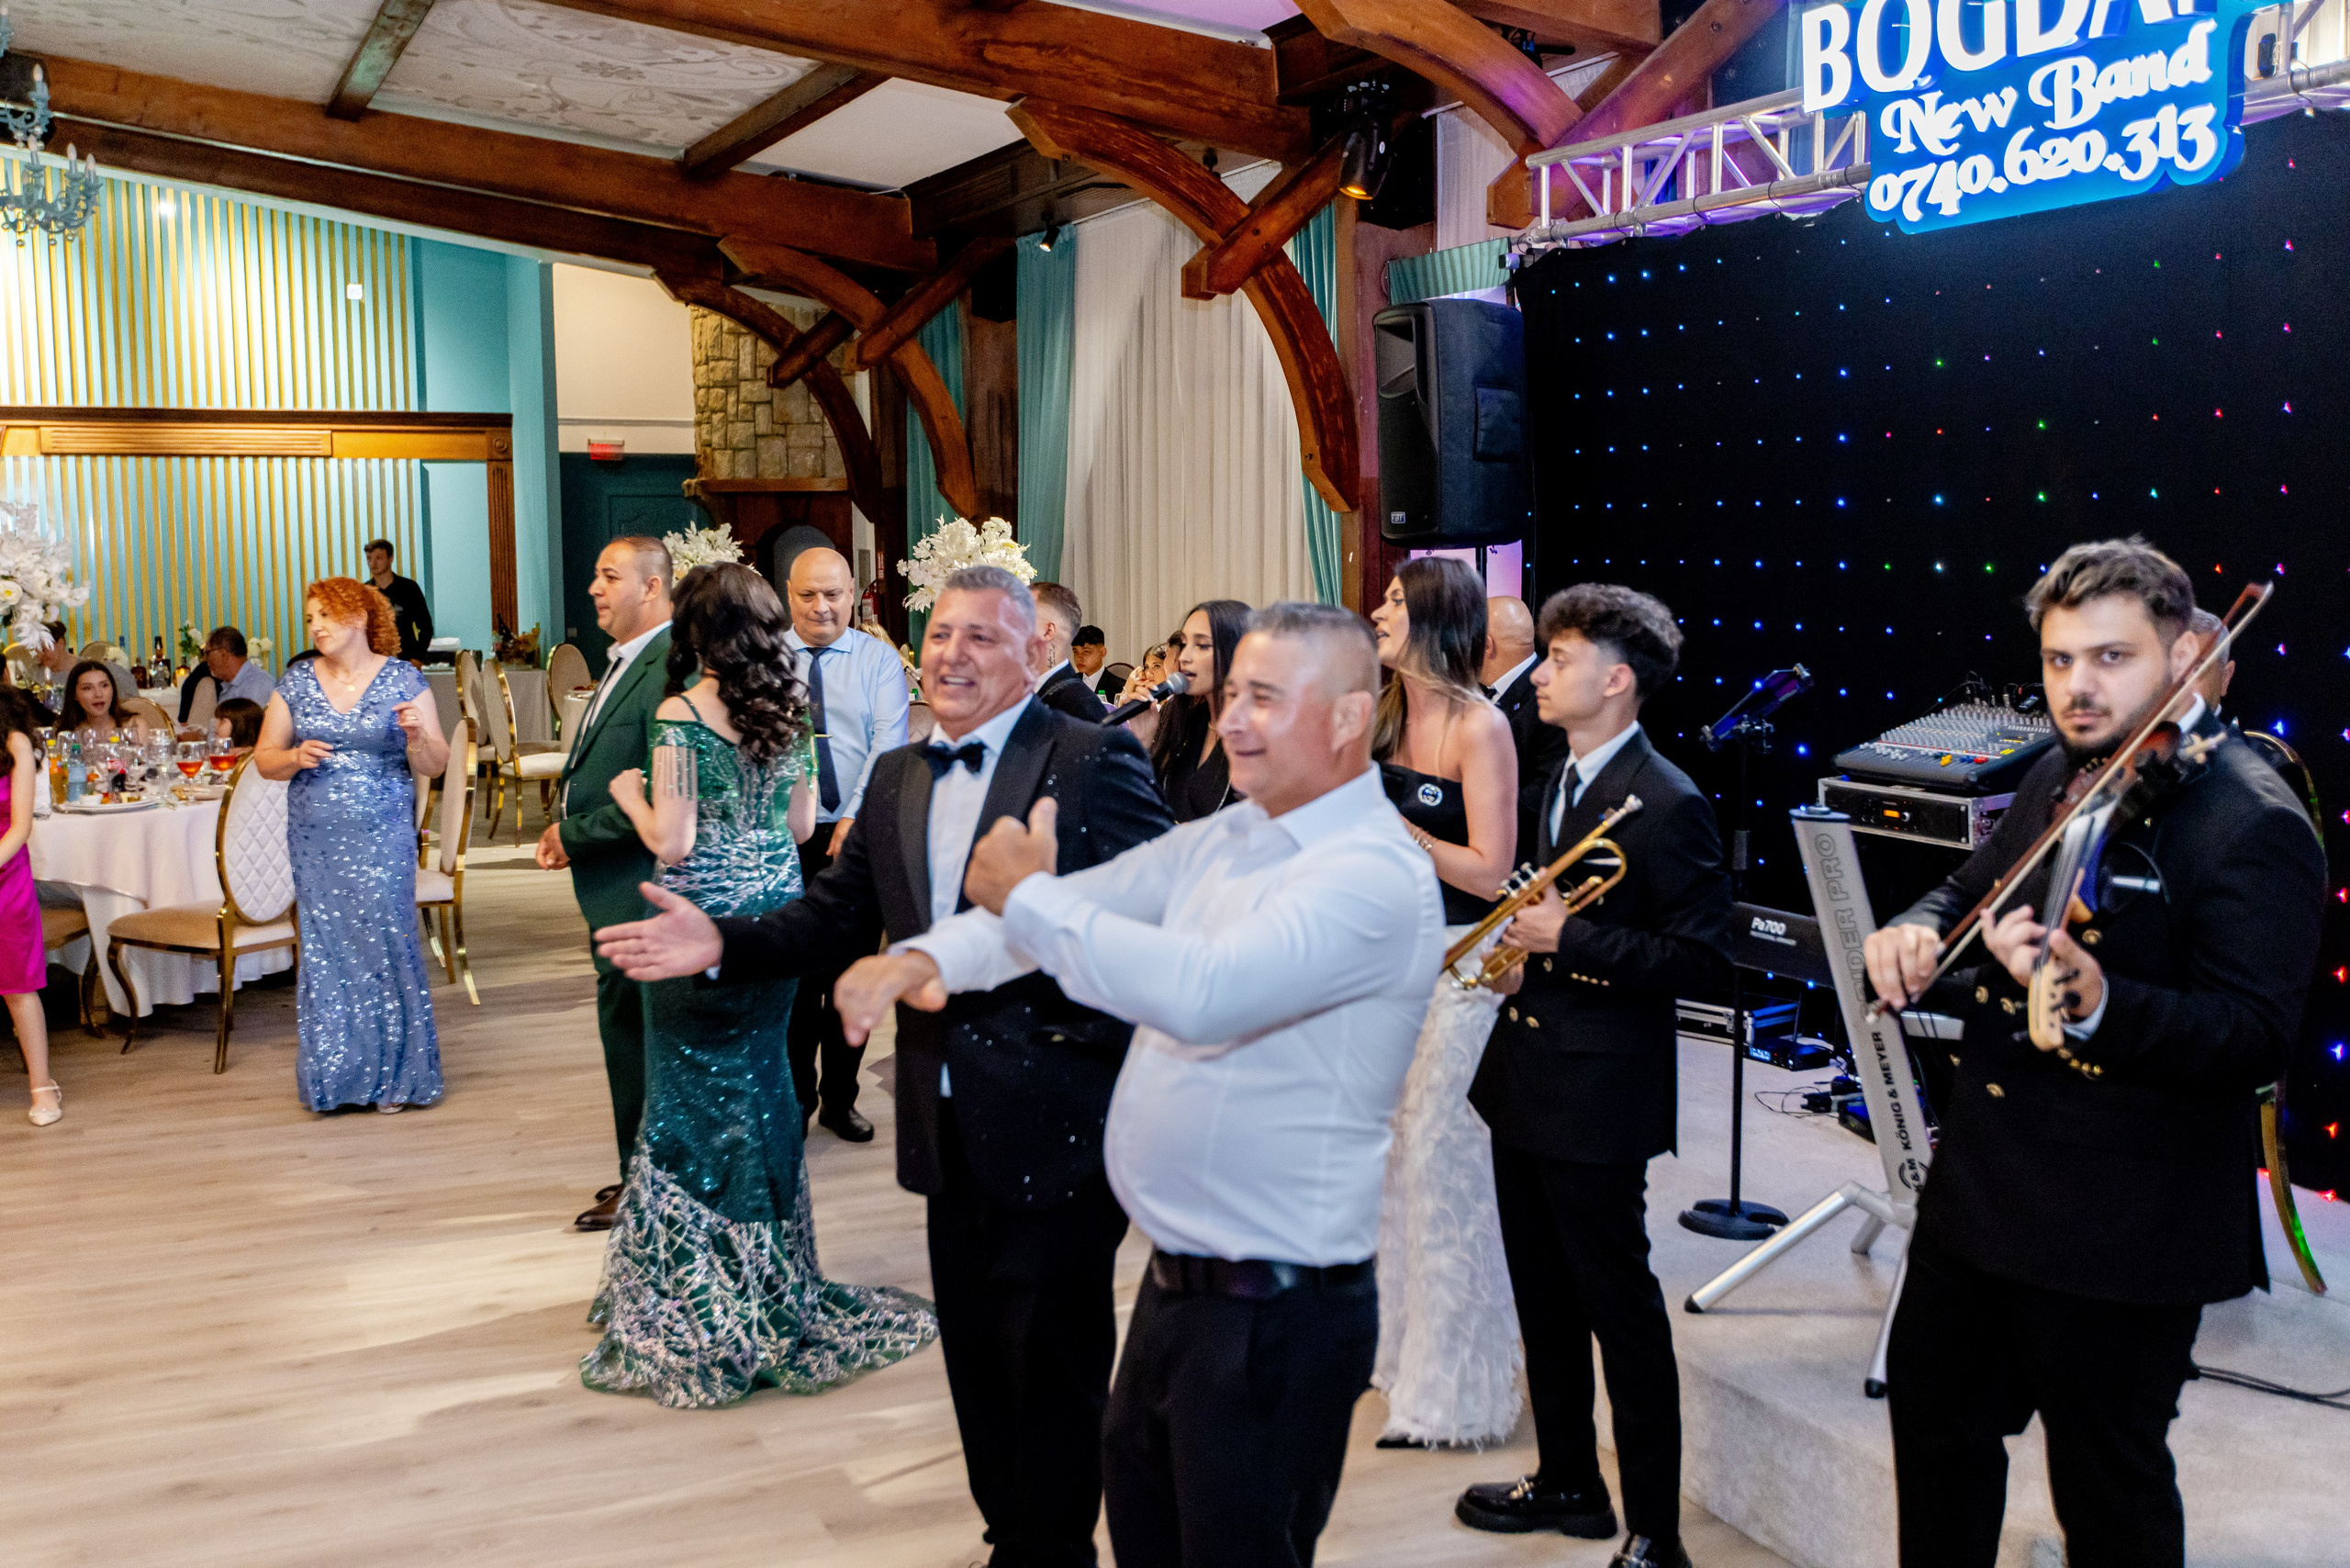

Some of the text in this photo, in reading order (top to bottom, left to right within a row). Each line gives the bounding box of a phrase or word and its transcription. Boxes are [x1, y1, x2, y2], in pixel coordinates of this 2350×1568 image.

[1801, 0, 2194, 113] BOGD
[1880, 18, 2218, 156] New Band
[1869, 103, 2218, 222] 0740.620.313
[1814, 833, 1850, 902] PRO
[1751, 917, 1786, 935] Pa700
[1871, 1032, 1913, 1150] KÖNIG & MEYER
